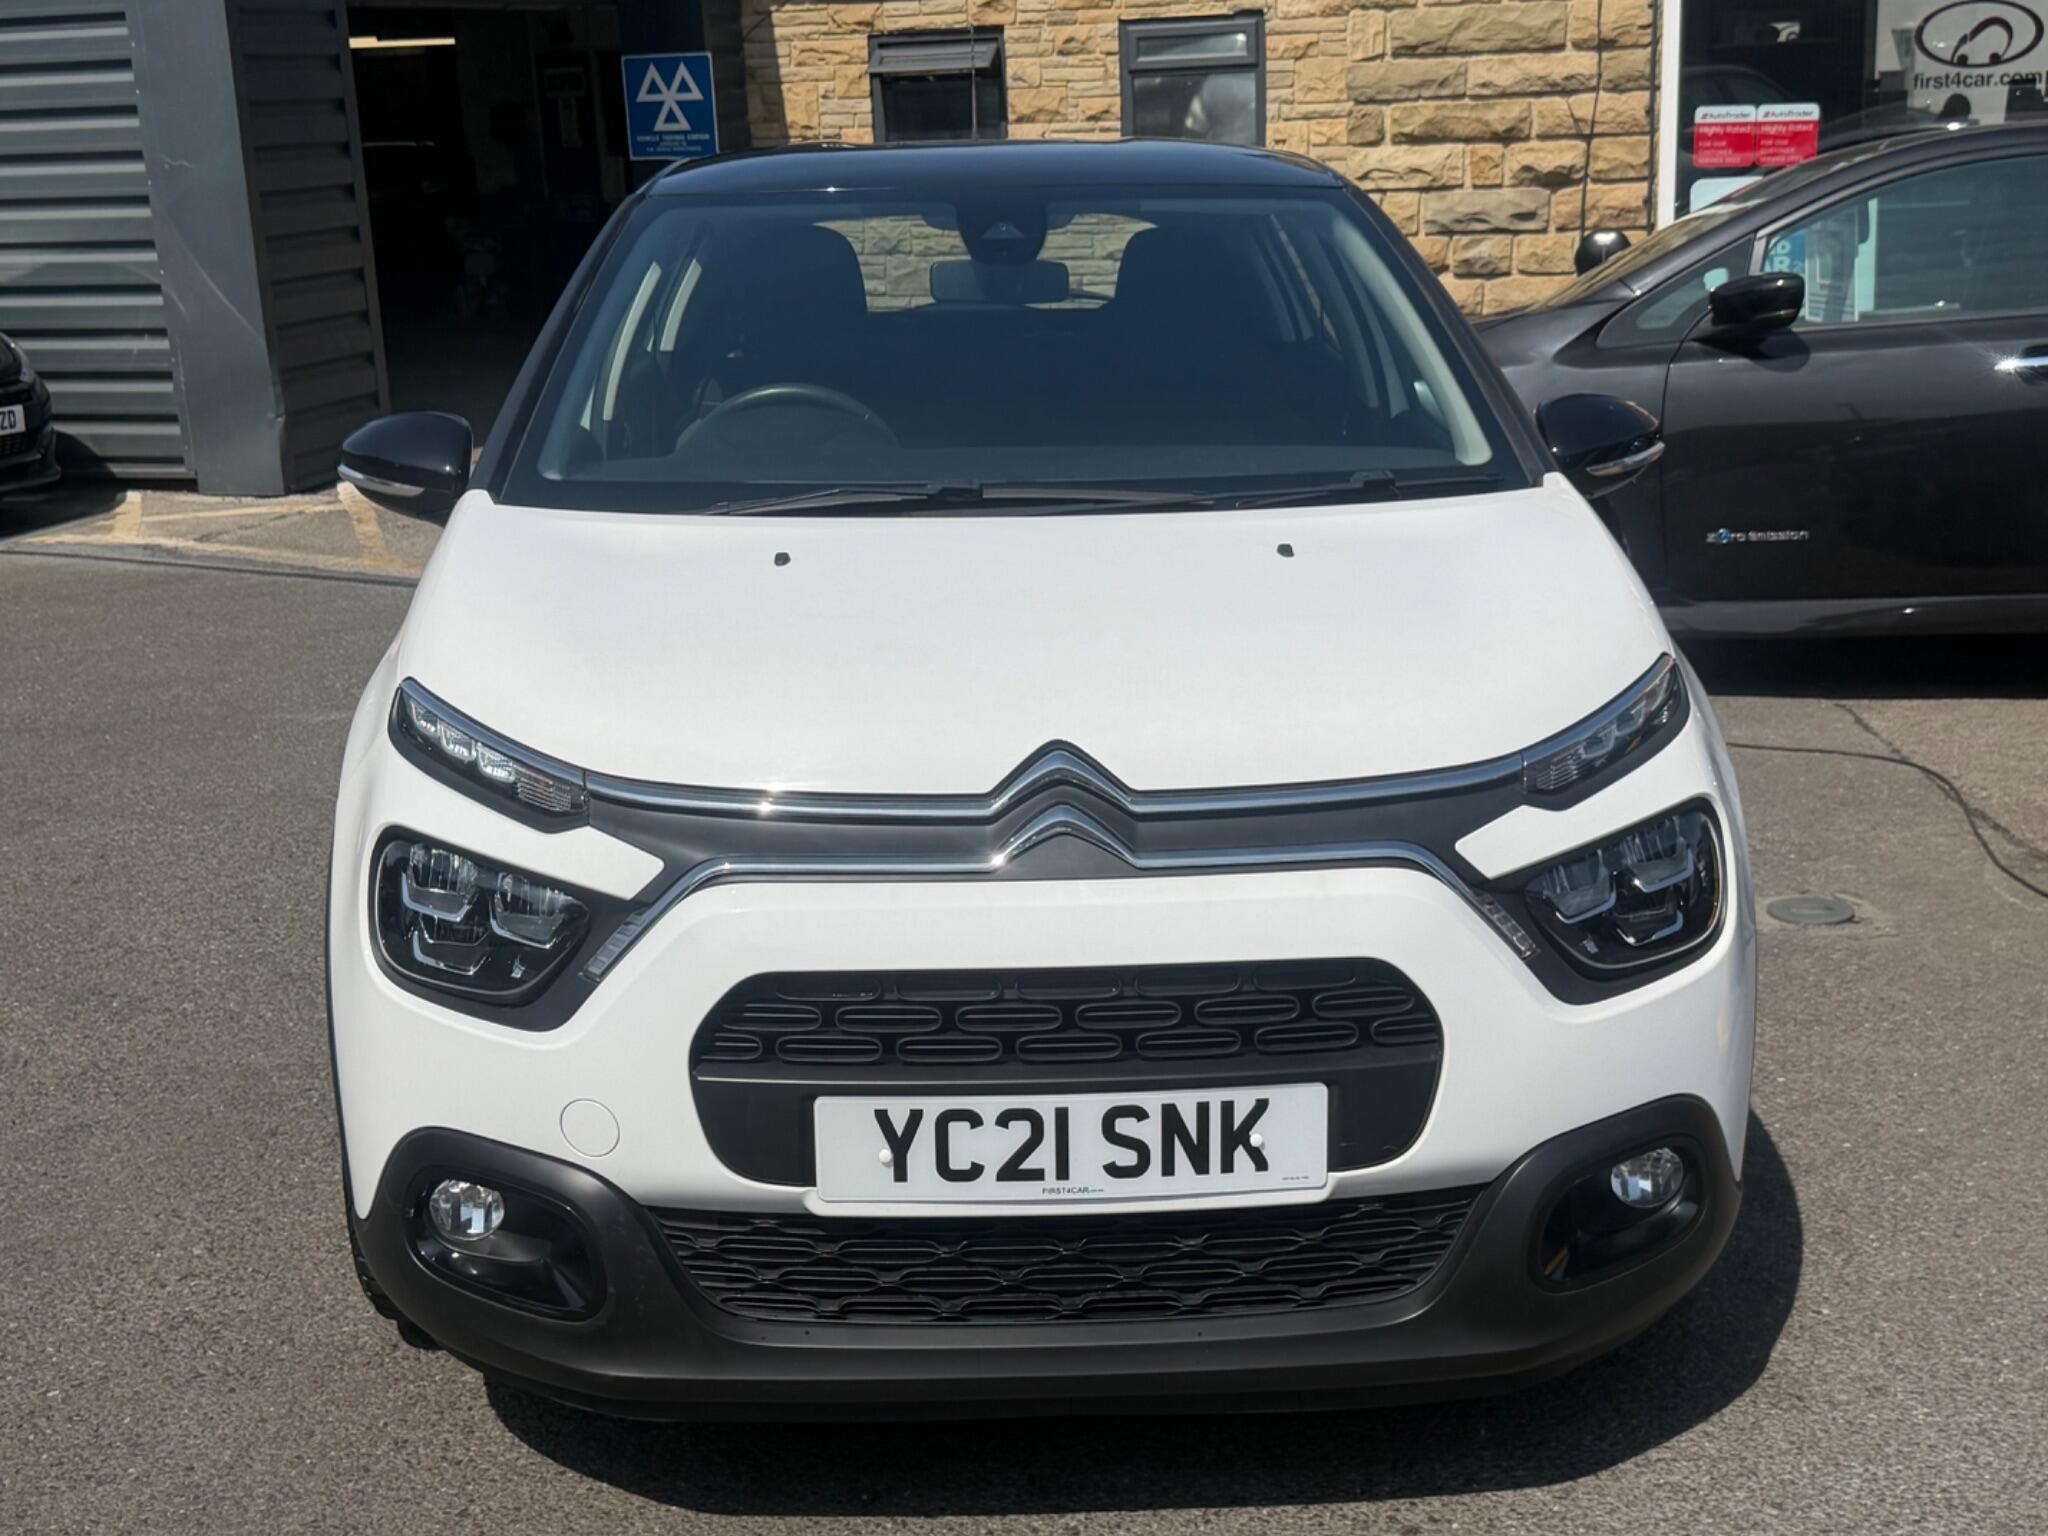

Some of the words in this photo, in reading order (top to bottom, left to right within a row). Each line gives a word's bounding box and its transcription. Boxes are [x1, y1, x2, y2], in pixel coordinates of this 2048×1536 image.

[1914, 72, 2043, 89] first4car.com
[873, 1106, 1070, 1183] YC21
[1102, 1098, 1270, 1180] SNK
